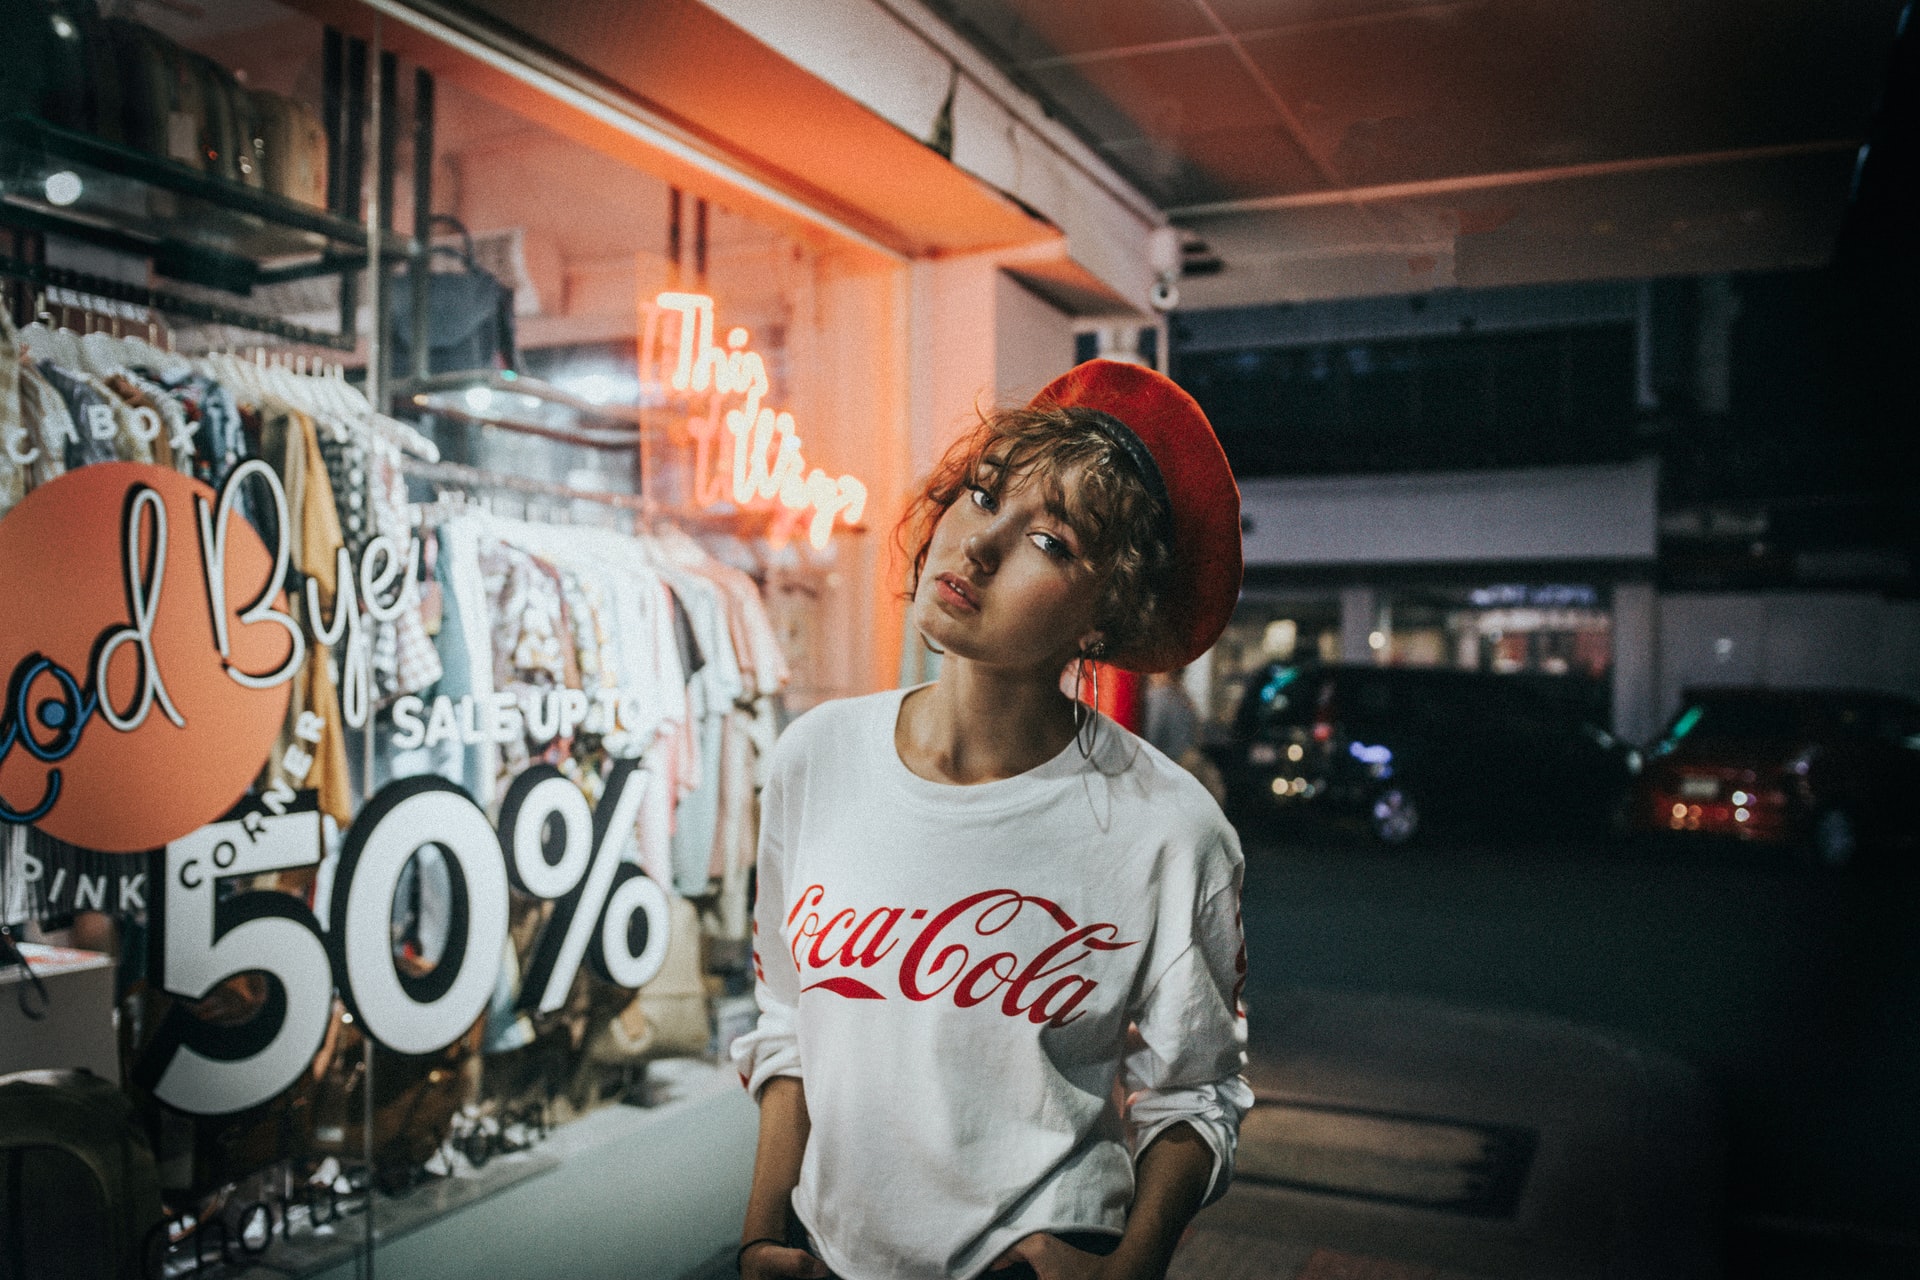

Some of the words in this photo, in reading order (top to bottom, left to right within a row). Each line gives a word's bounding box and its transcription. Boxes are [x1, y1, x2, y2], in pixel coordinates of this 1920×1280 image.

[657, 291, 768, 396] This
[199, 458, 421, 729] Bye
[392, 691, 520, 750] SALE
[526, 686, 588, 742] UP
[20, 852, 148, 912] PINK
[179, 710, 326, 889] CORNER
[153, 768, 671, 1115] 50%
[787, 883, 1140, 1028] Coca-Cola
